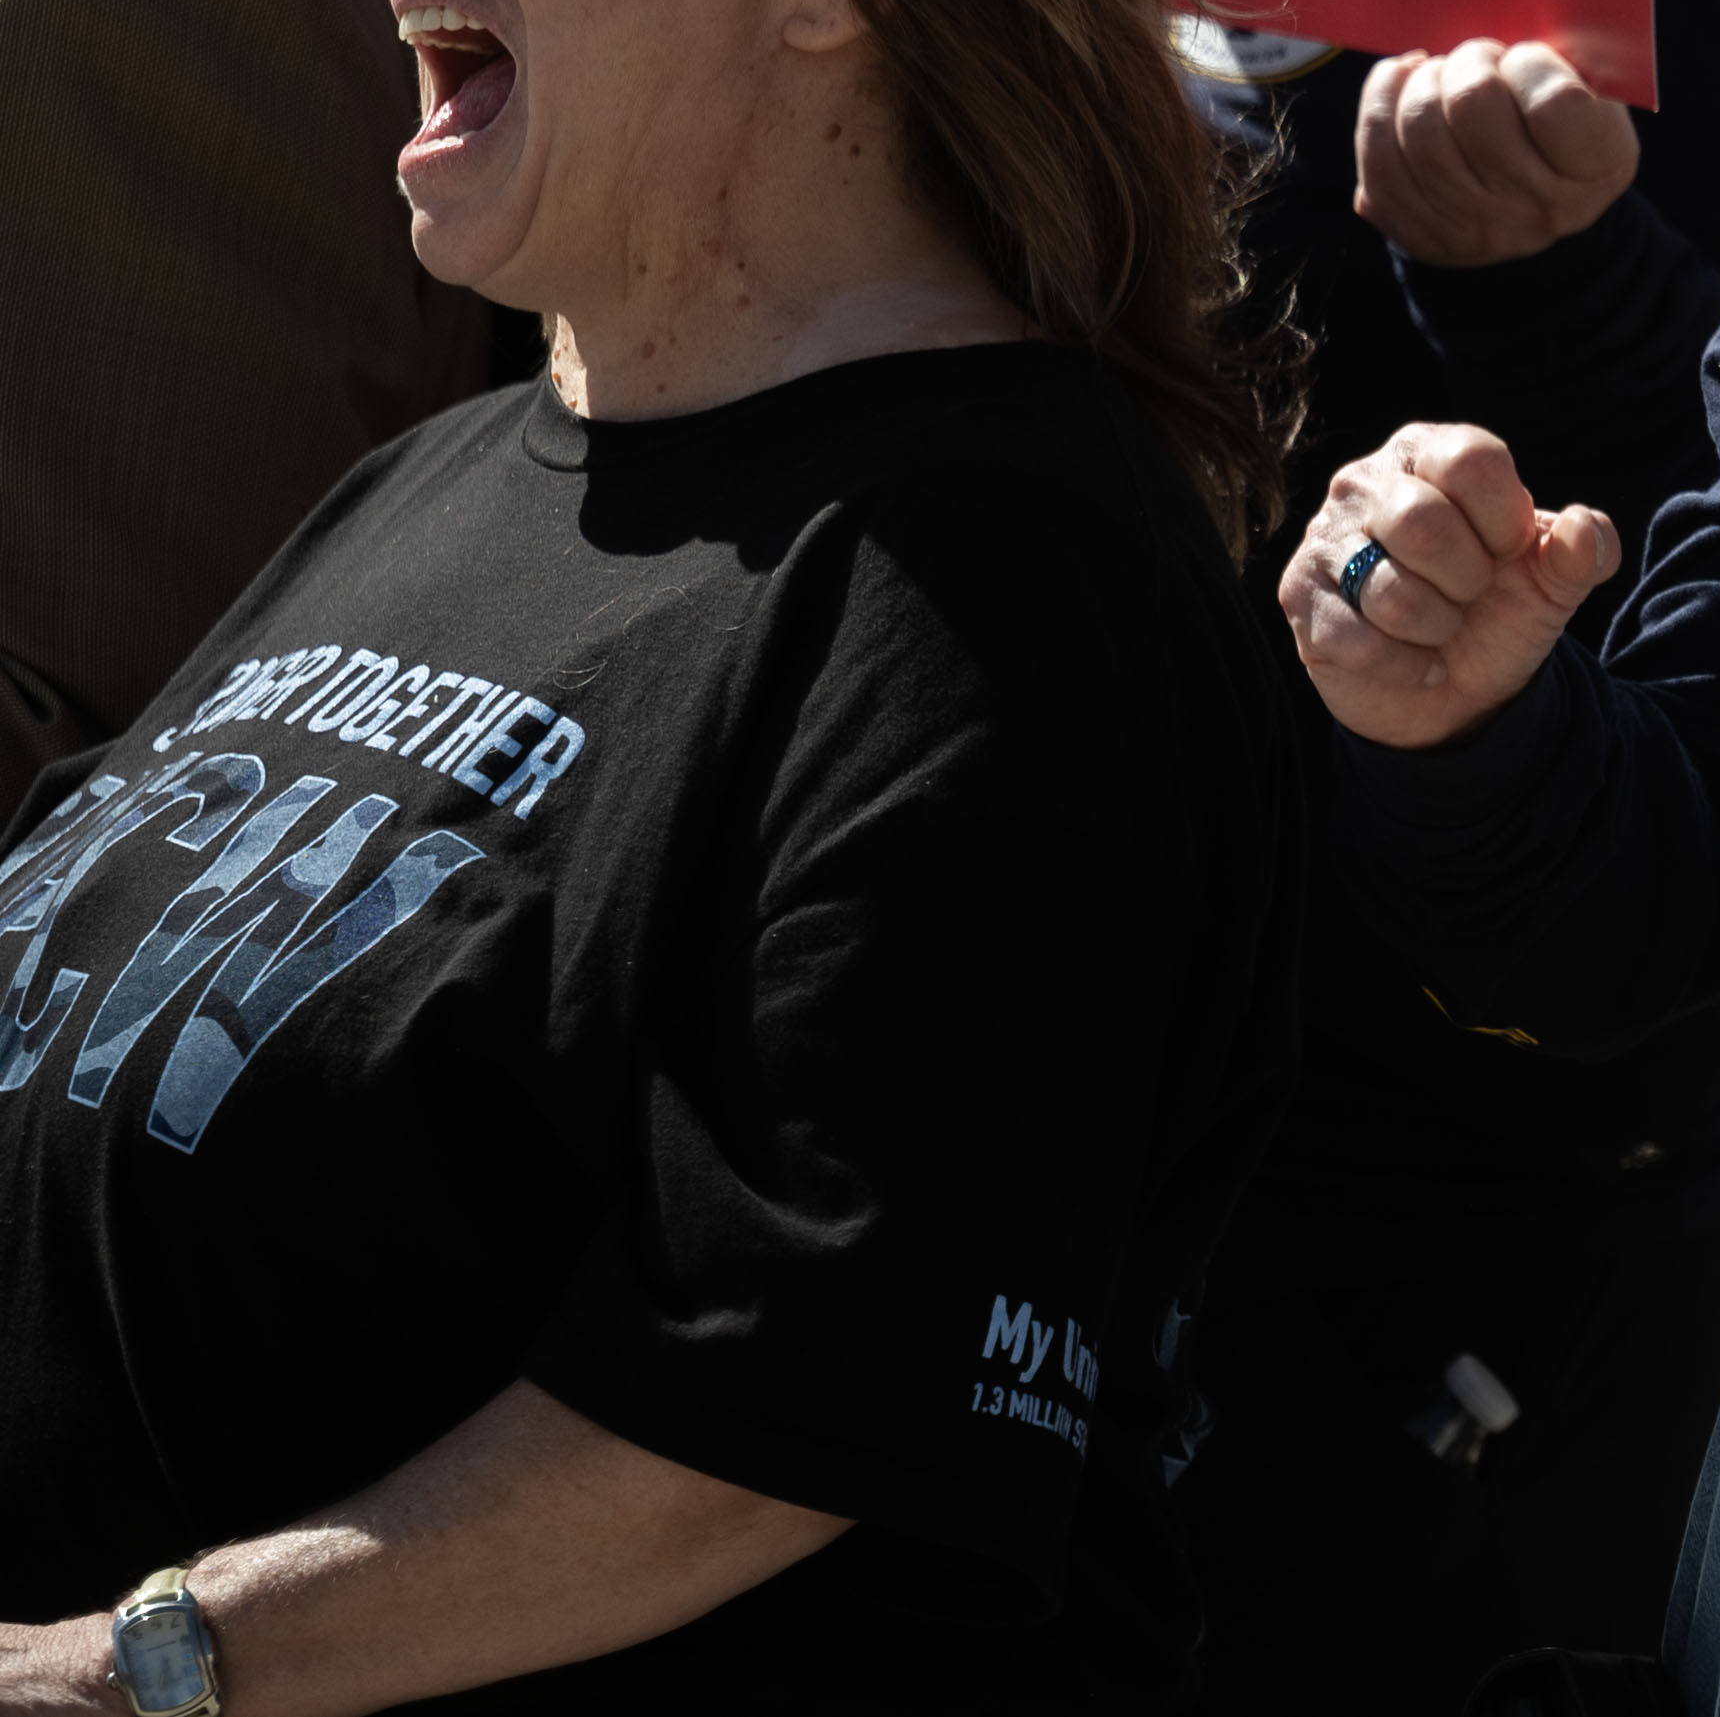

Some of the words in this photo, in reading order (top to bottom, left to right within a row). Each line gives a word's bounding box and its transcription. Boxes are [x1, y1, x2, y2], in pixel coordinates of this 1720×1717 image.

[284, 647, 586, 821] TOGETHER
[982, 1293, 1054, 1383] My
[971, 1382, 1006, 1416] 1.3
